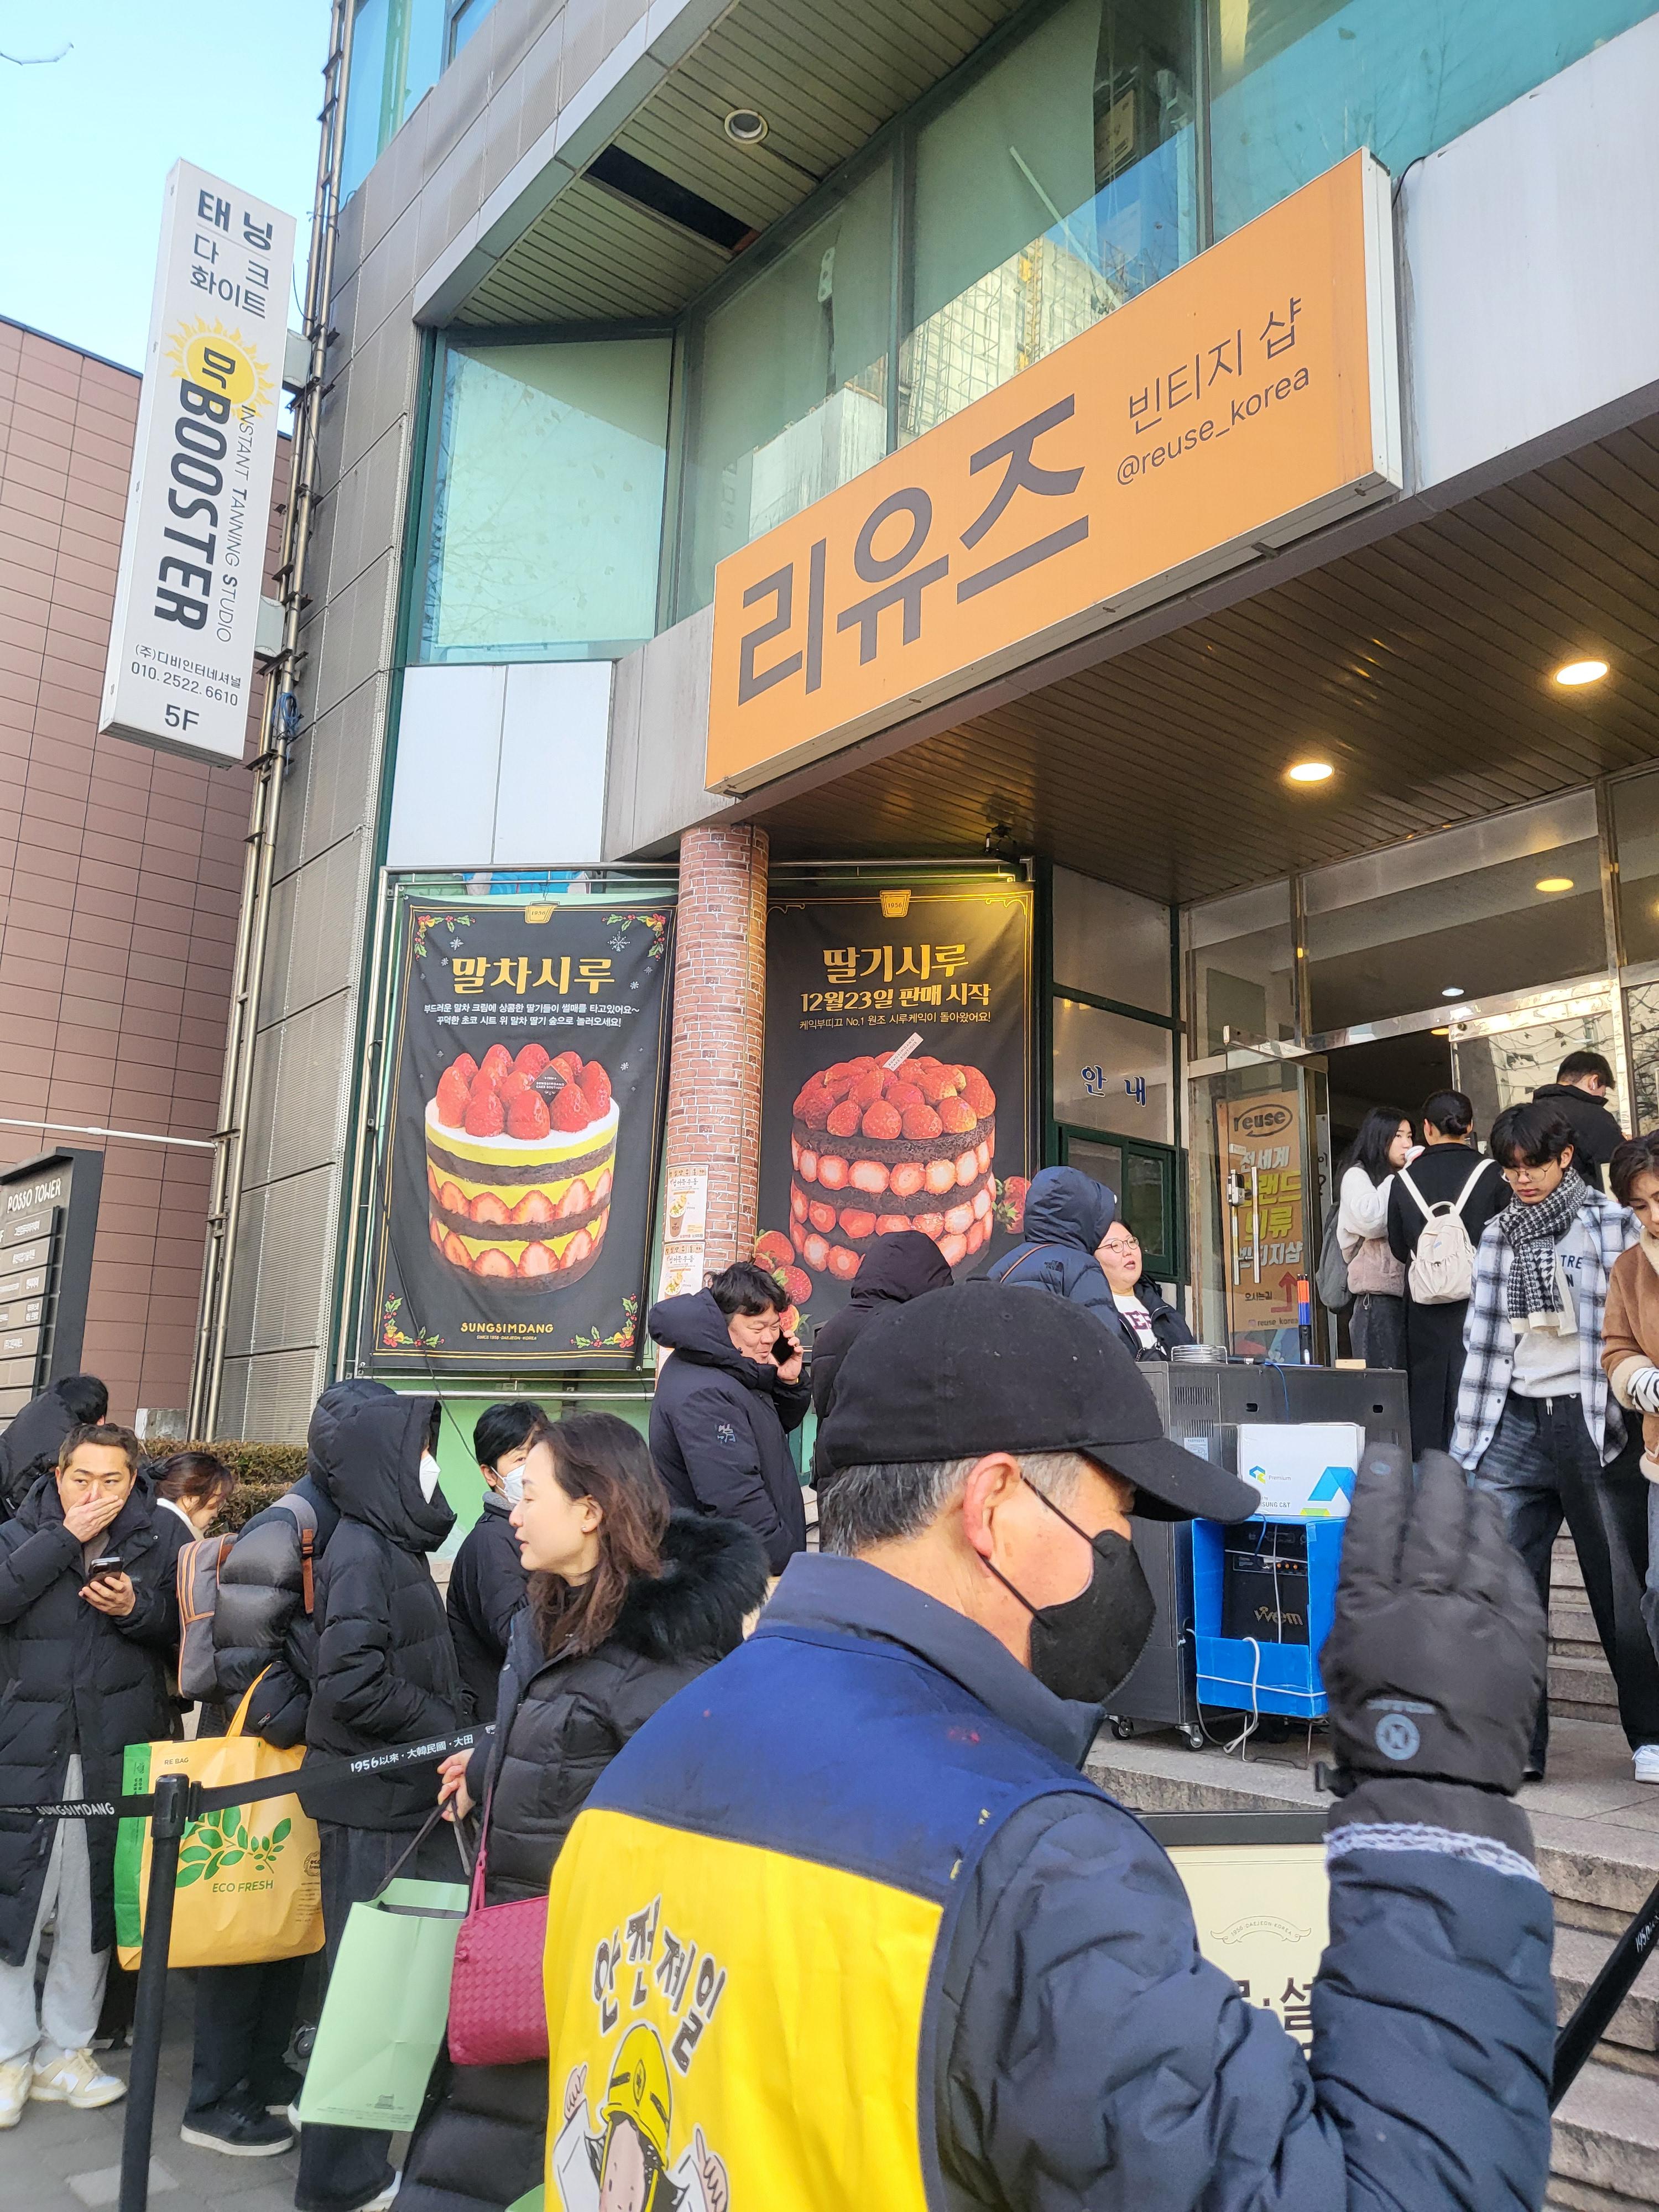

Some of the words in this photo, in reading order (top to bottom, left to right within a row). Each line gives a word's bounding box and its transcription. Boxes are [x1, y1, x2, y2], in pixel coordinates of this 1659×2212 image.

[190, 264, 266, 319] 화이트
[1129, 328, 1243, 435] 빈티지
[1260, 296, 1302, 361] 샵
[232, 404, 256, 481] INSTANT
[1116, 366, 1310, 486] @reuse_korea
[225, 487, 247, 567] TANNING
[738, 393, 1089, 706] 리유즈
[216, 574, 238, 643] STUDIO
[135, 644, 241, 689] (주)디비인터네셔널
[164, 703, 200, 731] 5F
[451, 956, 615, 995] 말차시루
[823, 943, 968, 984] 딸기시루
[424, 1004, 453, 1014] 부드러운
[454, 1004, 470, 1012] 말차
[471, 1003, 497, 1013] 크림에
[526, 1004, 560, 1013] 딸기들이
[561, 1004, 587, 1014] 썰매를
[801, 988, 893, 1012] 12월23일
[898, 985, 942, 1007] 판매
[946, 983, 992, 1006] 시작
[436, 1015, 460, 1025] 꾸덕한
[461, 1015, 478, 1025] 초코
[479, 1015, 497, 1025] 시트
[499, 1016, 508, 1025] 위
[510, 1016, 528, 1025] 말차
[529, 1016, 546, 1025] 딸기
[548, 1015, 574, 1025] 숲으로
[576, 1016, 622, 1027] 놀러오세요!
[846, 1017, 864, 1027] No.1
[867, 1015, 886, 1026] 원조
[889, 1013, 936, 1025] 시루케익이
[940, 1011, 991, 1023] 돌아왔어요!
[1081, 1065, 1146, 1108] 안내
[1234, 1111, 1285, 1131] reuse
[1240, 1146, 1290, 1173] 전세계
[34, 1177, 61, 1204] TOWER
[1245, 1291, 1272, 1301] 오시는길
[460, 1322, 554, 1333] SUNGSIMDANG
[212, 1883, 236, 1893] ECO
[238, 1880, 274, 1892] FRESH
[593, 1895, 726, 2073] 안전제일
